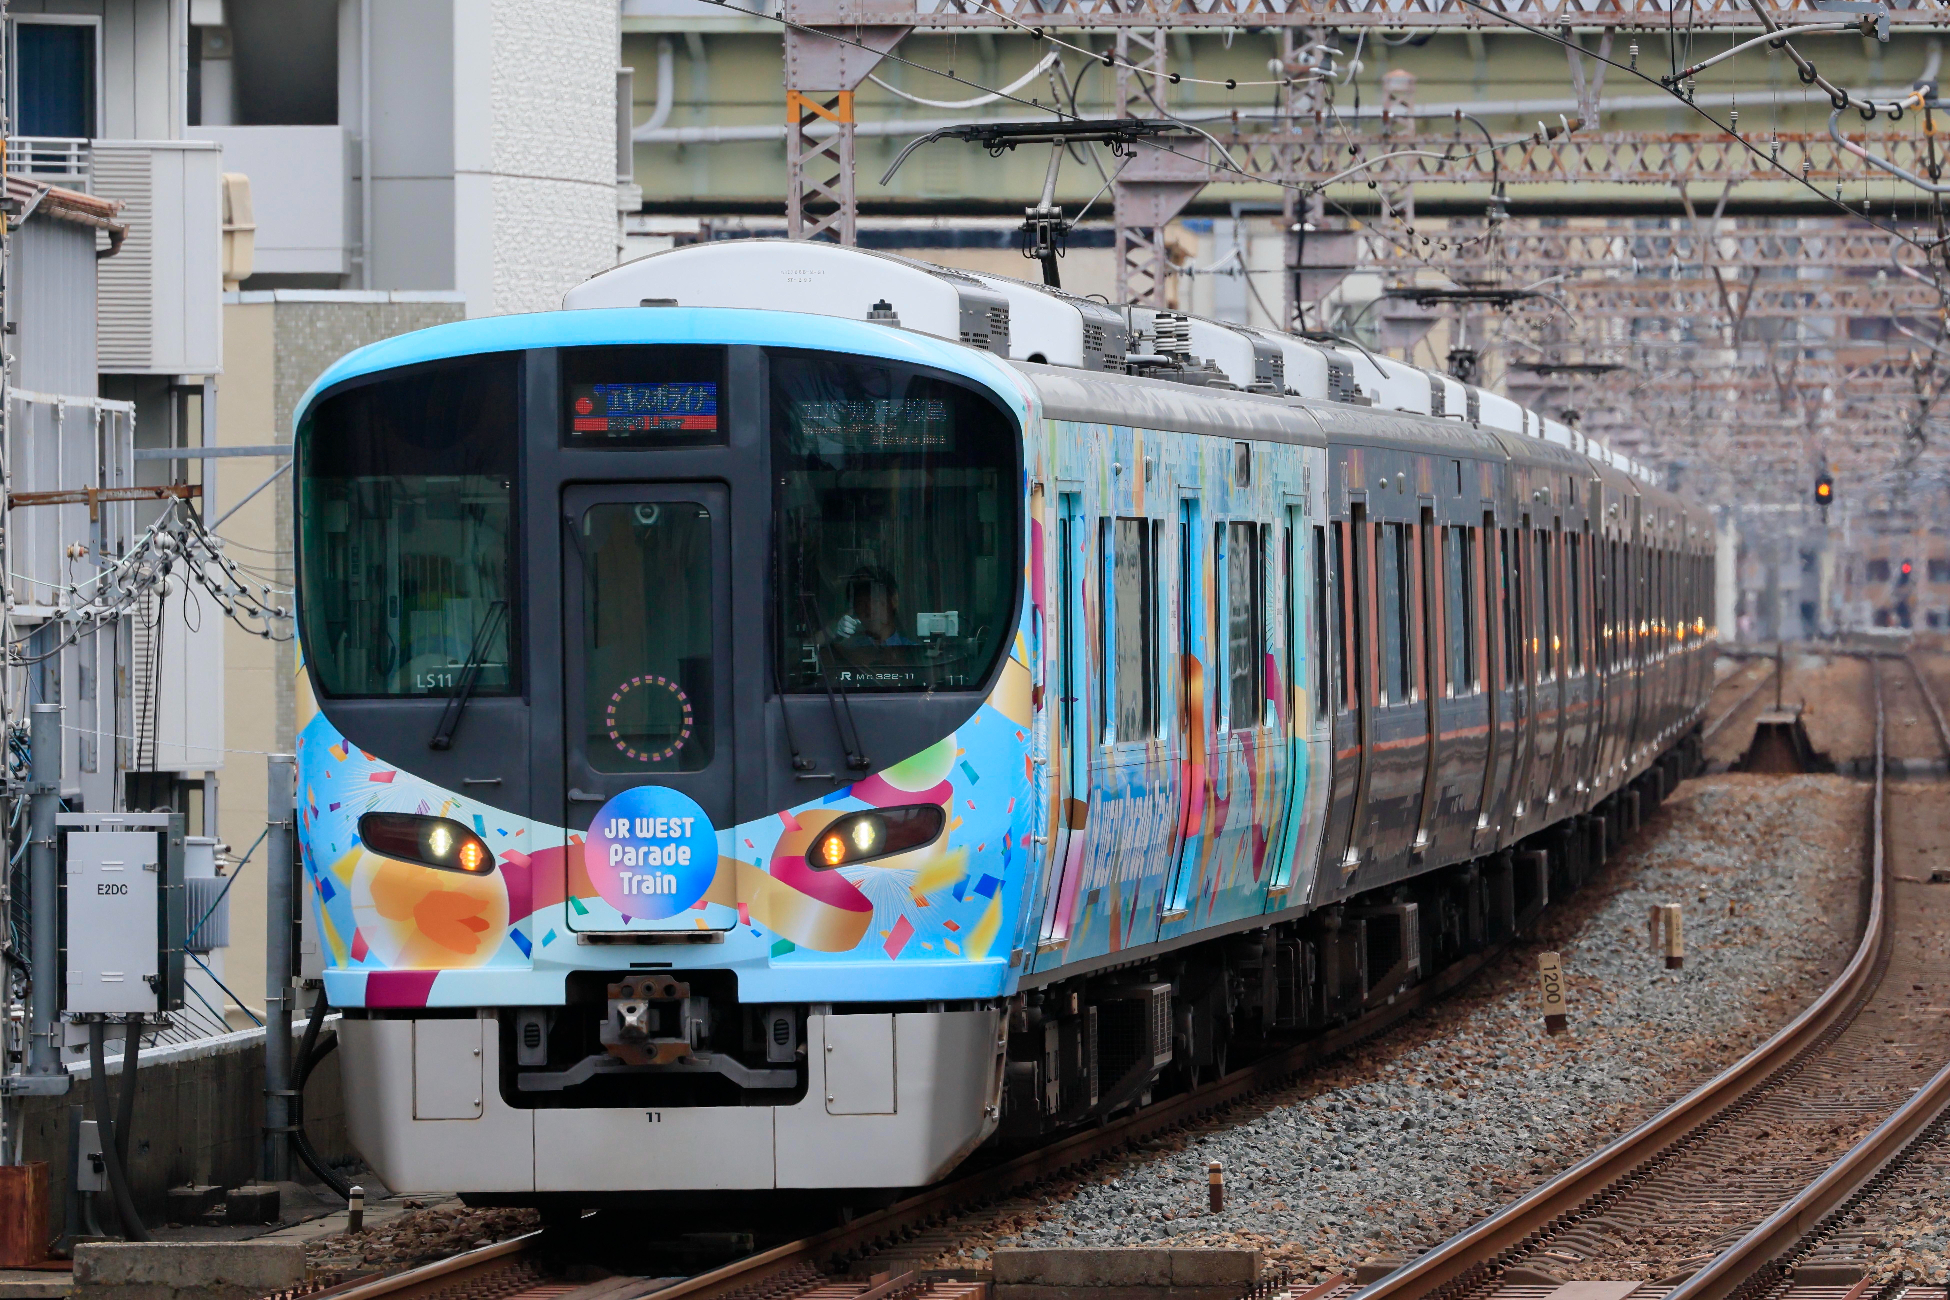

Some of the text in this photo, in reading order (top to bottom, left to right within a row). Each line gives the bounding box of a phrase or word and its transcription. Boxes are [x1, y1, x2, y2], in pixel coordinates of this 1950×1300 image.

[417, 673, 452, 688] LS11
[604, 817, 695, 839] JR WEST
[609, 842, 692, 867] Parade
[97, 884, 128, 895] E2DC
[619, 871, 677, 895] Train
[1543, 964, 1561, 1005] 1200
[646, 1112, 661, 1122] 11
